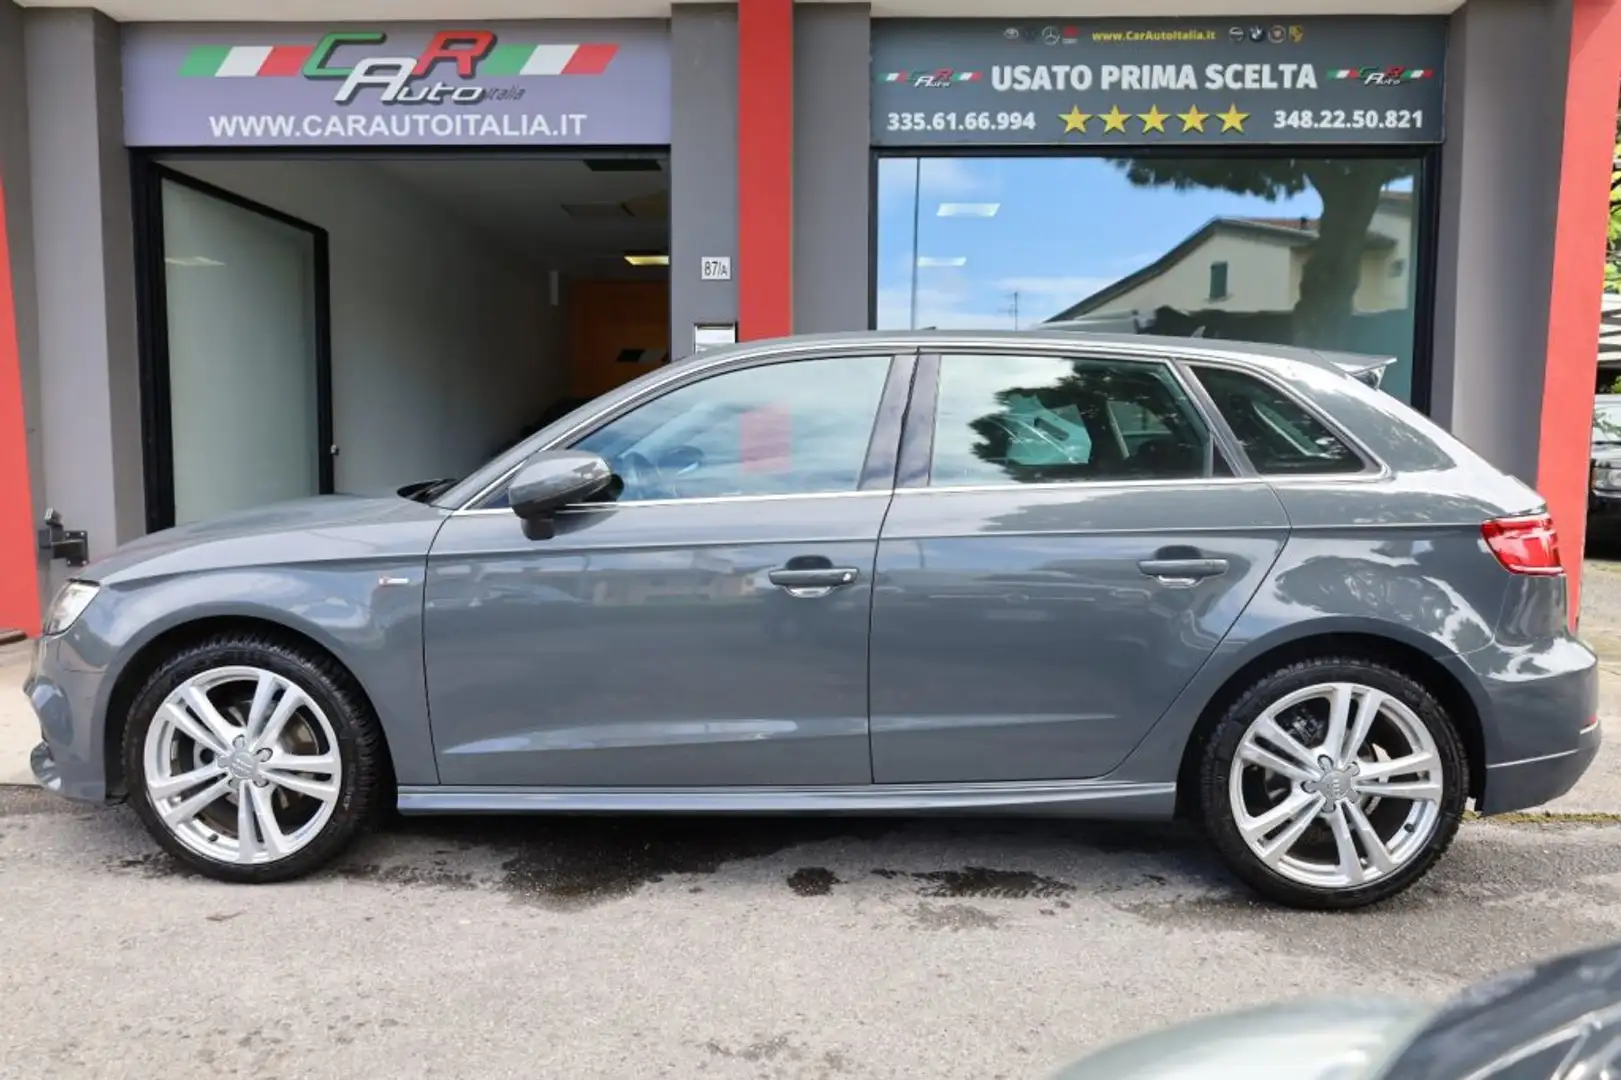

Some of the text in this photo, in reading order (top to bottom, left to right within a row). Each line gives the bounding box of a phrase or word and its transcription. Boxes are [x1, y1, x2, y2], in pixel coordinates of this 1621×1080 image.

[991, 64, 1318, 91] USATO PRIMA SCELTA
[209, 113, 588, 138] WWW.CARAUTOITALIA.IT
[887, 112, 1037, 131] 335.61.66.994
[1273, 110, 1423, 129] 348.22.50.821
[704, 260, 728, 277] 87/A
